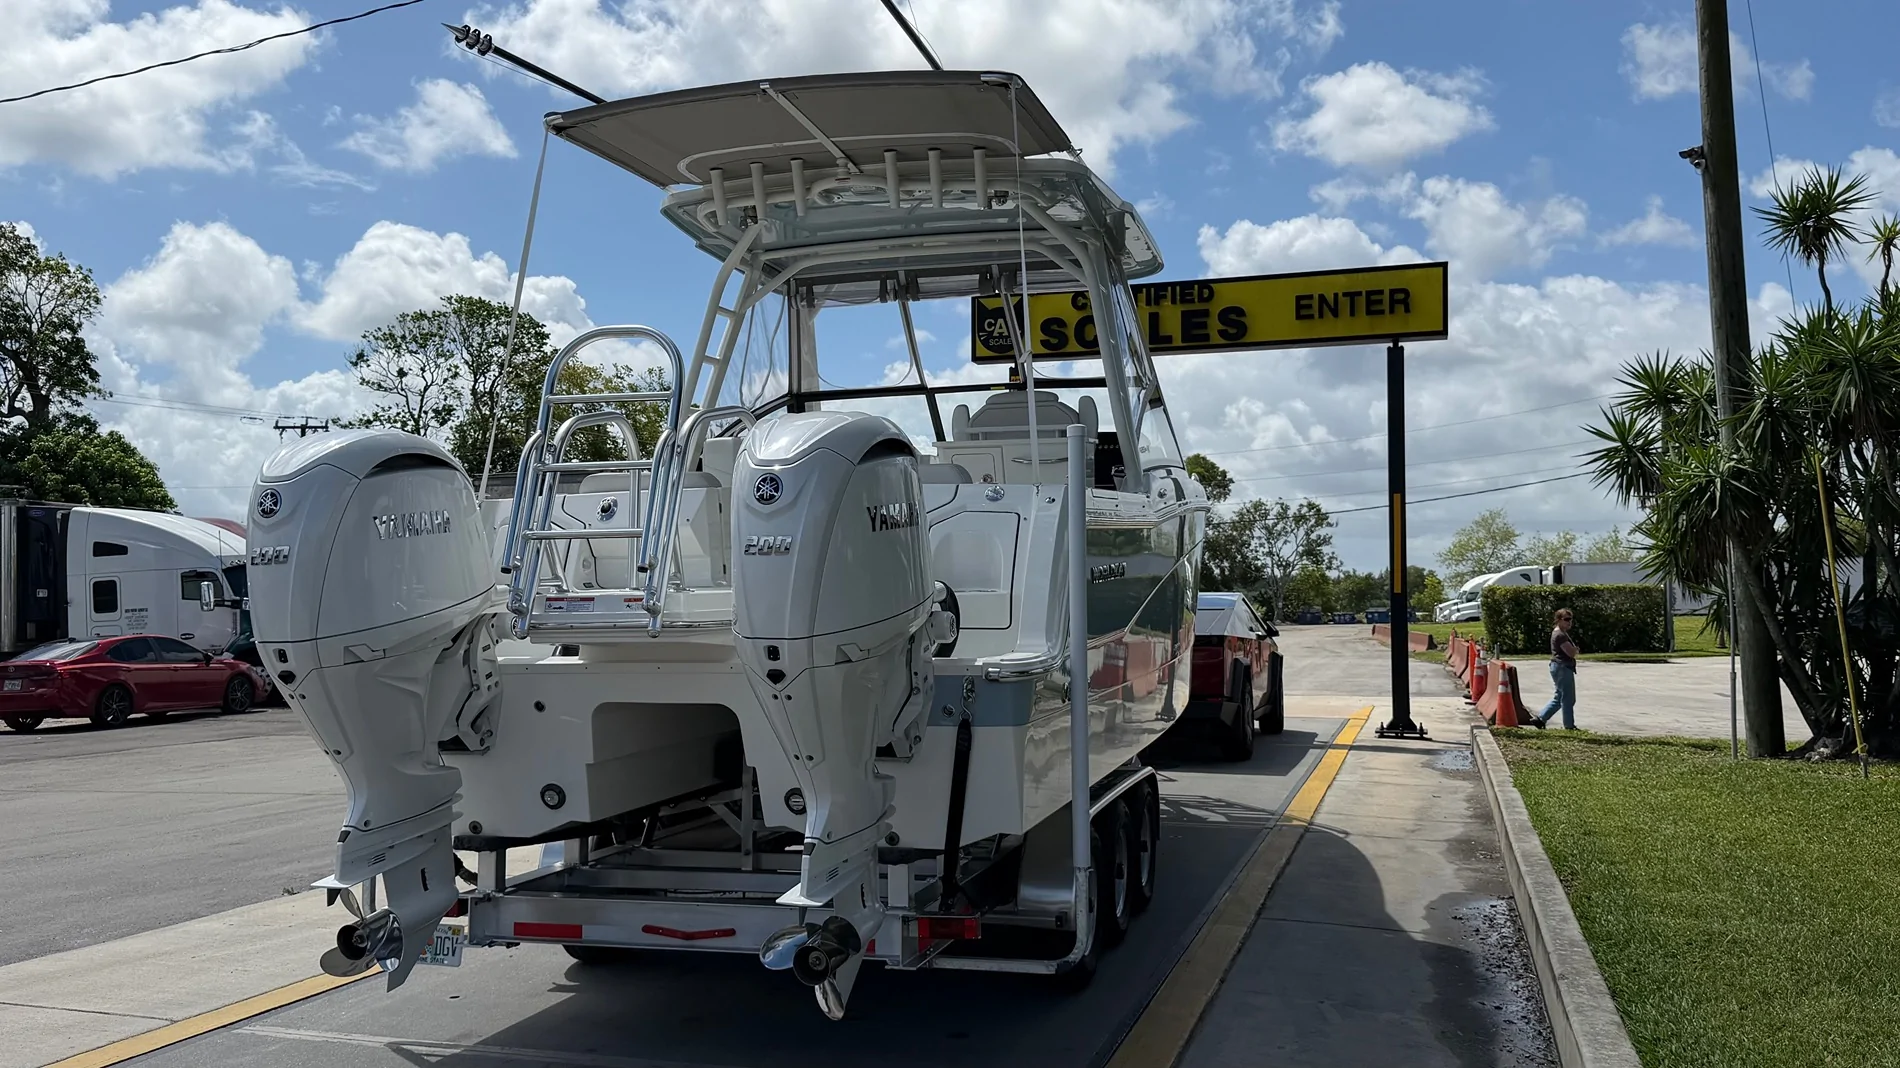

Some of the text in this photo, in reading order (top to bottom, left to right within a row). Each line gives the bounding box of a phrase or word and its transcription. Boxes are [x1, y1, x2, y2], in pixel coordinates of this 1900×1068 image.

[1295, 288, 1411, 320] ENTER
[1039, 306, 1247, 351] SCLES
[989, 338, 1014, 346] SCALE
[373, 510, 452, 540] YAMAHA
[250, 545, 290, 566] 200
[744, 535, 793, 556] 200
[434, 936, 459, 957] DGV
